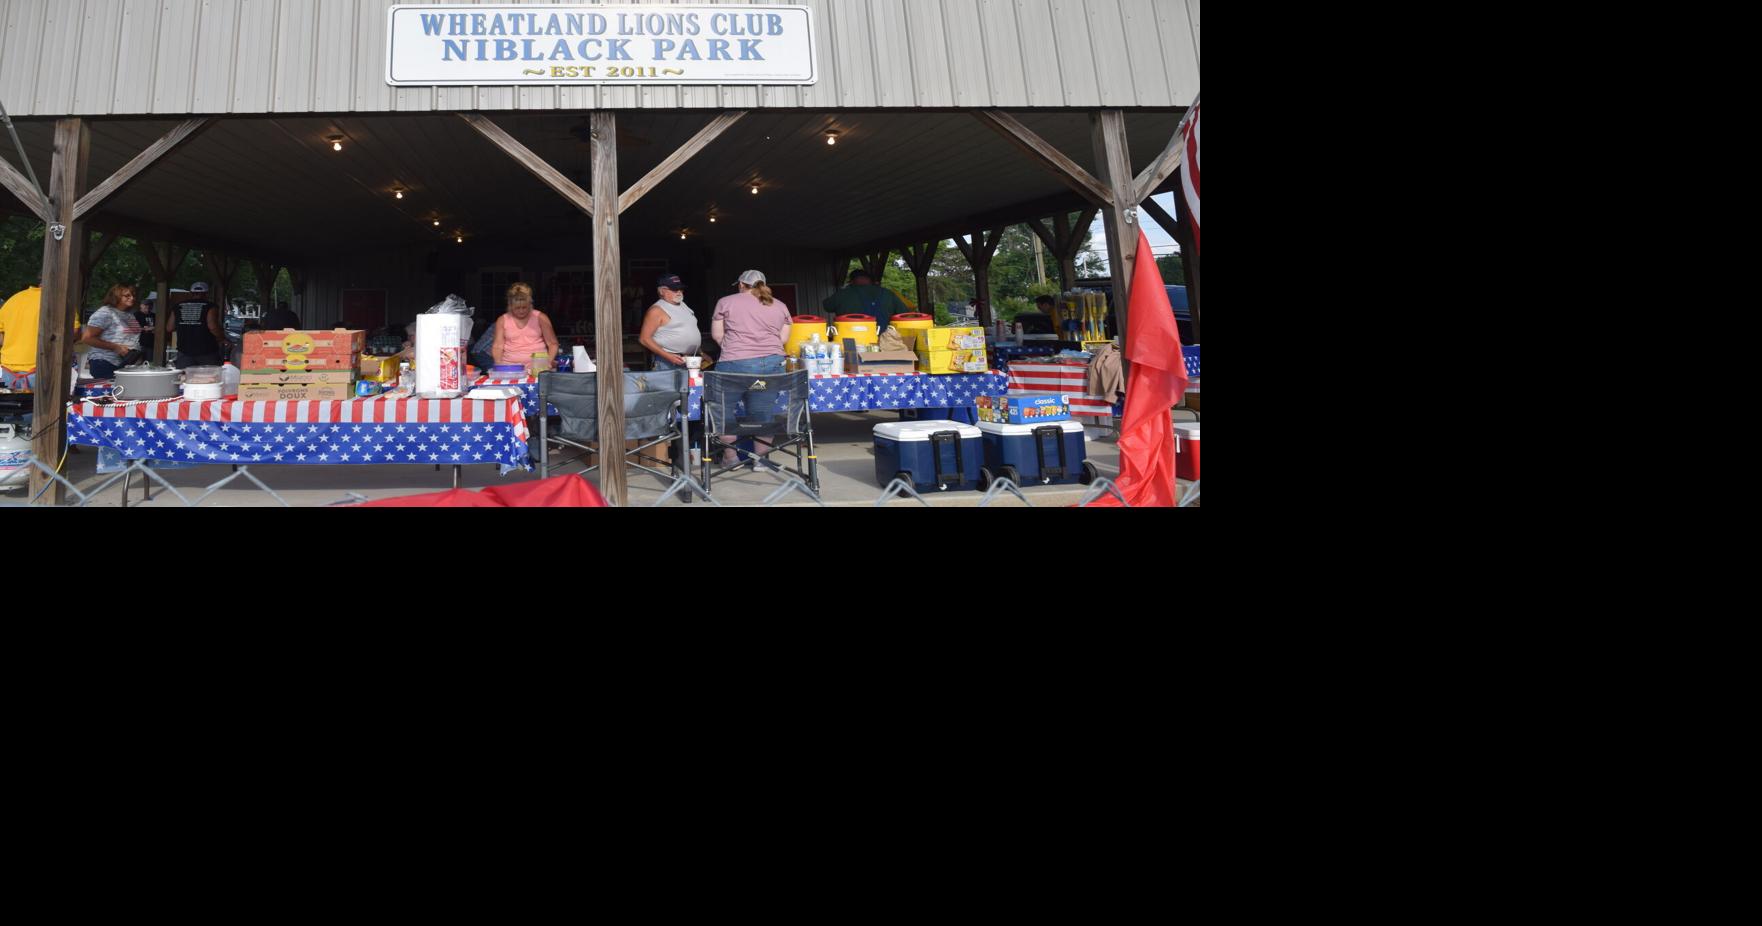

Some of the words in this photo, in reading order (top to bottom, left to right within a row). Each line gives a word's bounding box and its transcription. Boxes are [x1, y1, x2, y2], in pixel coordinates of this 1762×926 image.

[420, 12, 608, 37] WHEATLAND
[616, 12, 701, 36] LIONS
[710, 12, 784, 36] CLUB
[441, 38, 634, 62] NIBLACK
[651, 38, 766, 61] PARK
[549, 65, 597, 78] EST
[606, 65, 659, 78] 2011
[1034, 397, 1056, 405] classic
